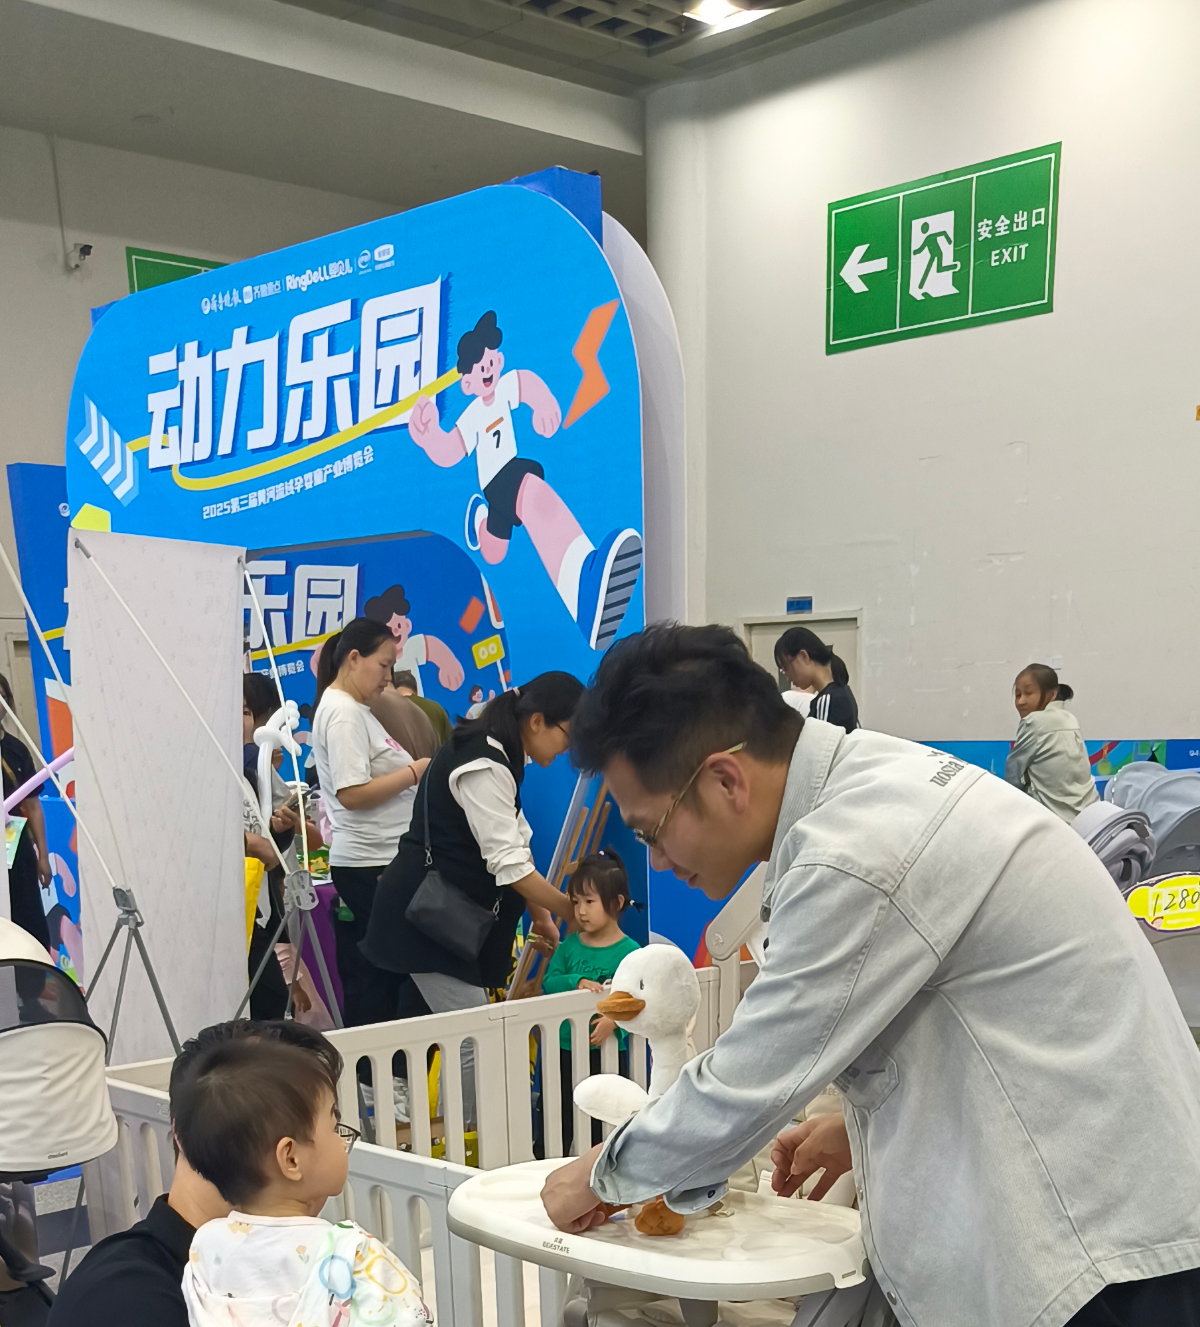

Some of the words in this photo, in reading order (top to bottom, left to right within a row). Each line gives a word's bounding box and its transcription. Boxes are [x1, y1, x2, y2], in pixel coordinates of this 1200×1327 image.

[977, 207, 1046, 241] 安全出口
[991, 243, 1029, 266] EXIT
[148, 274, 443, 469] 动力乐园
[492, 429, 502, 449] 7
[1153, 888, 1200, 917] 1280
